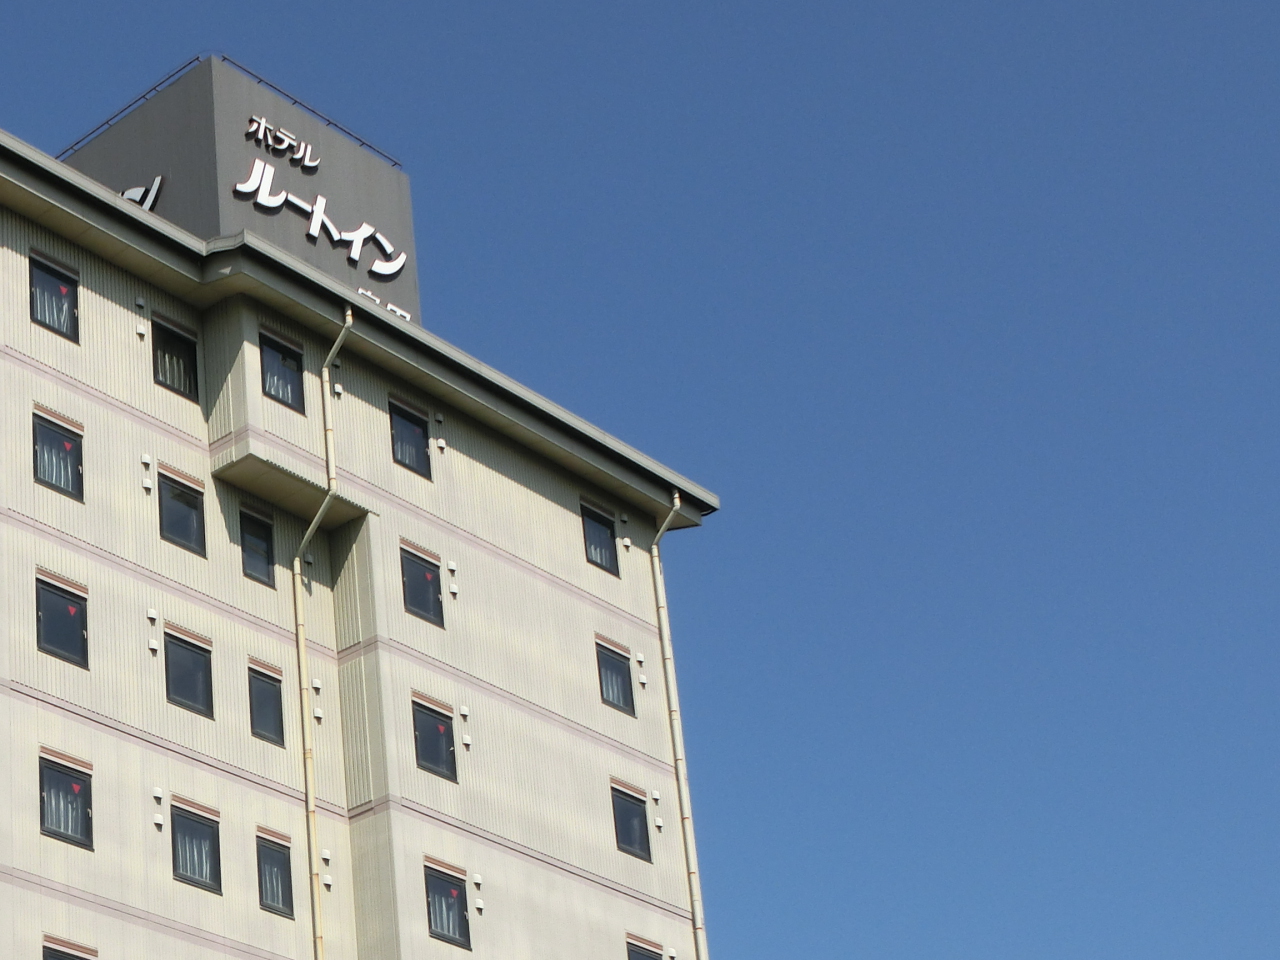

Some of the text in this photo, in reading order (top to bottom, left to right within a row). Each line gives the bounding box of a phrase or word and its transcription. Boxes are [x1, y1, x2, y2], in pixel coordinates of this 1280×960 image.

[248, 115, 321, 167] ホテル
[235, 158, 407, 275] ルートイン
